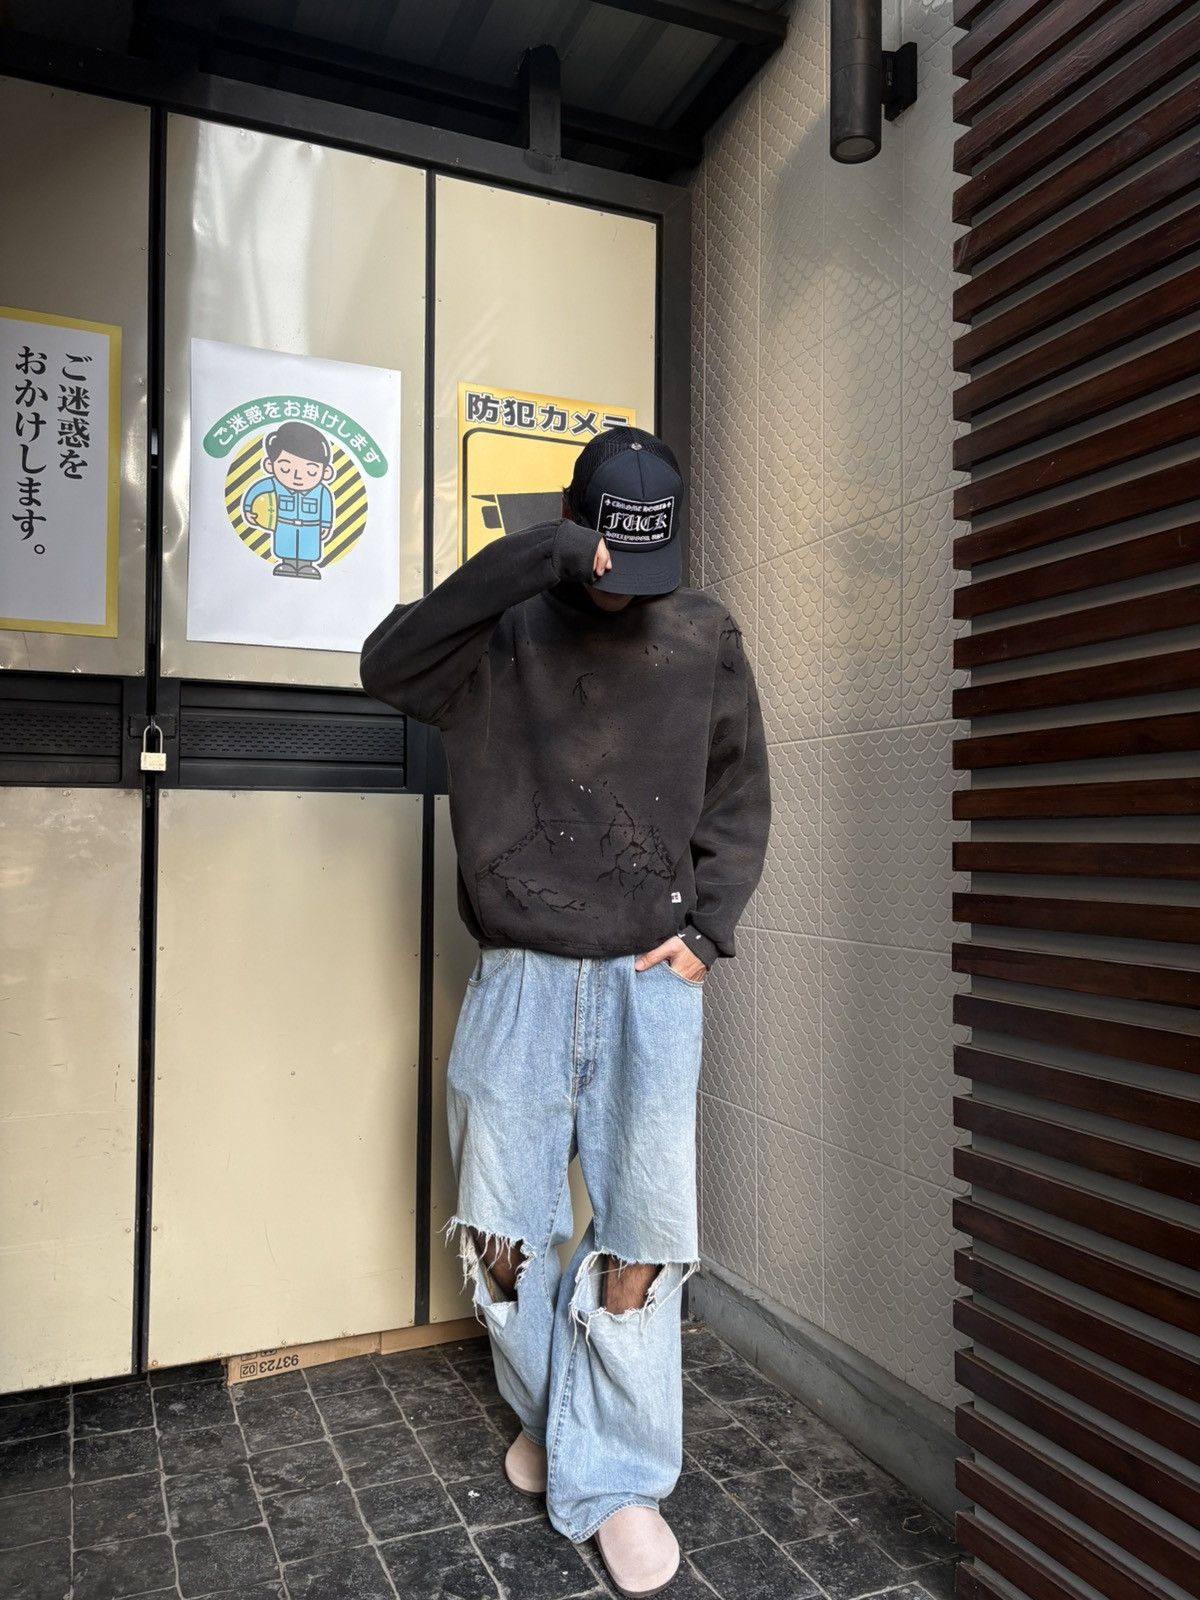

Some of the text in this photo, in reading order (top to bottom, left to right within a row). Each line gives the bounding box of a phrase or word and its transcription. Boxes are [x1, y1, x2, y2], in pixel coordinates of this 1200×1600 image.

[57, 352, 92, 480] ご迷惑を
[213, 399, 383, 465] ご迷惑をお掛けします
[12, 345, 48, 555] おかけします。
[603, 511, 668, 532] FUCK
[242, 1354, 299, 1375] 93723 02
